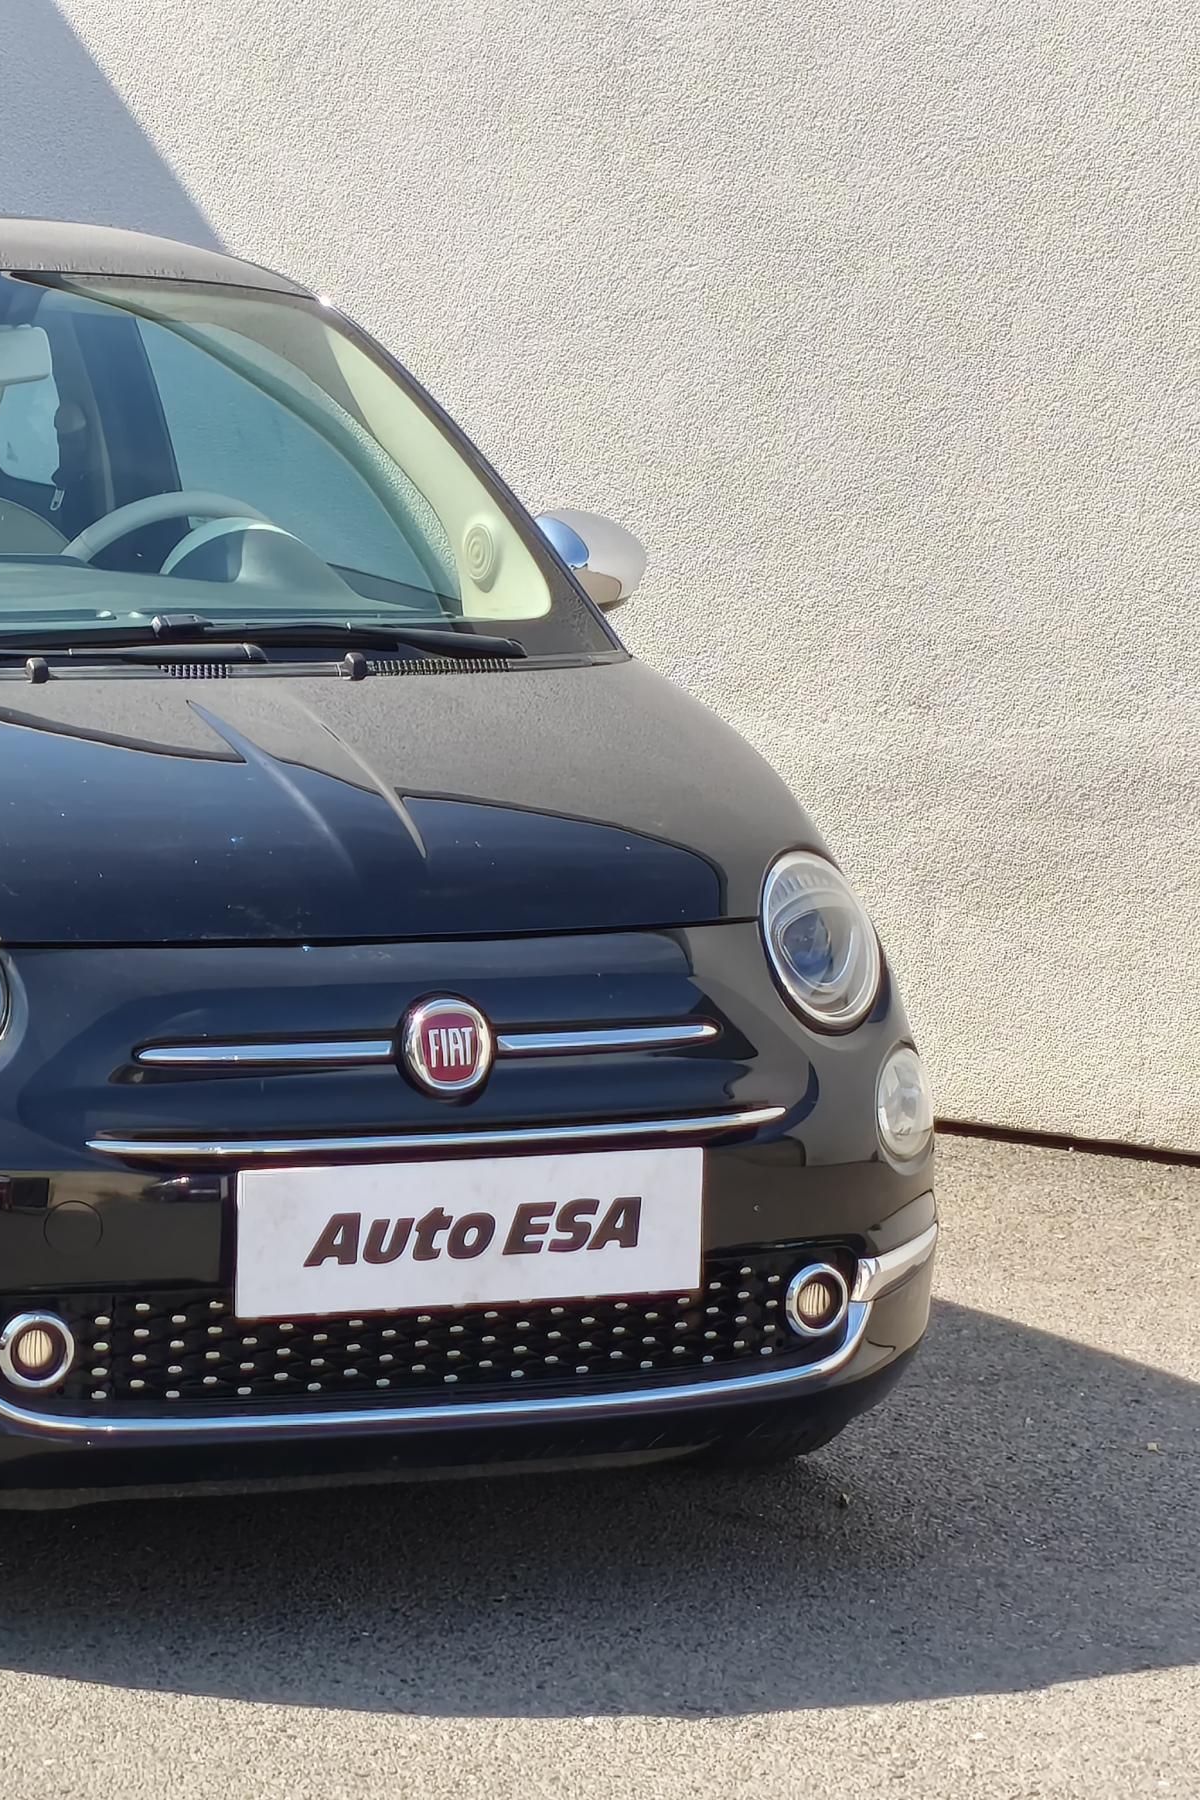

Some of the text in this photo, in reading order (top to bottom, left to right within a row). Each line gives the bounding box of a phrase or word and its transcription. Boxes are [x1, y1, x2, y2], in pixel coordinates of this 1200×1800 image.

[428, 1026, 473, 1068] FIAT
[303, 1196, 642, 1267] Auto ESA
